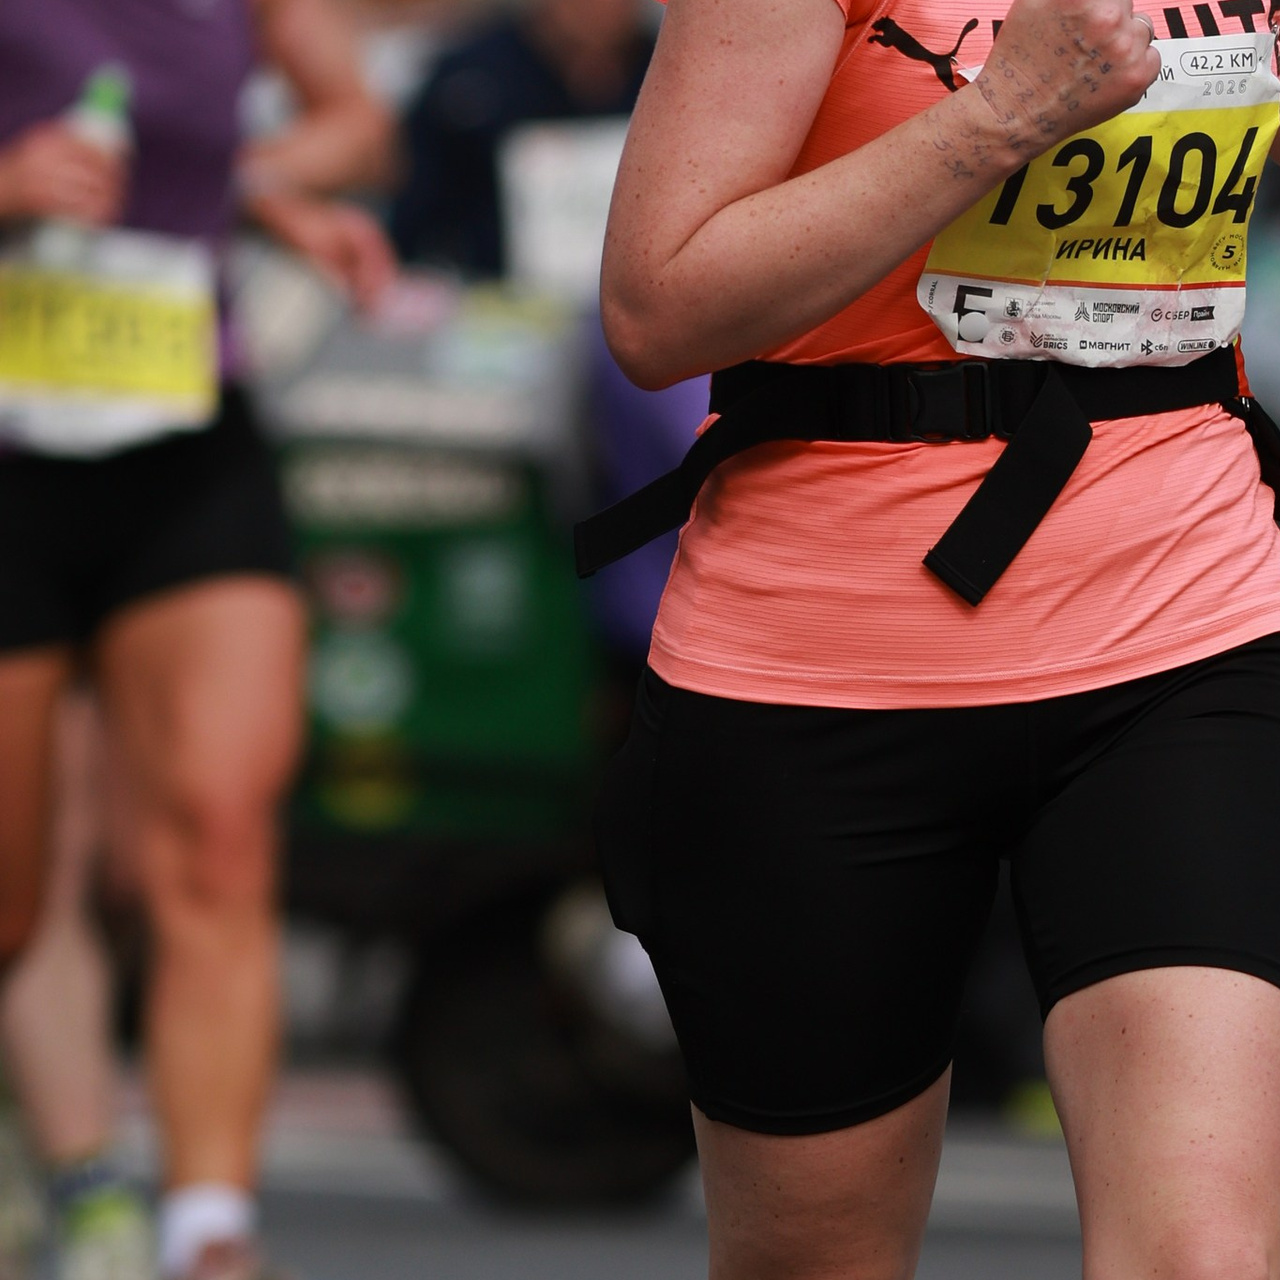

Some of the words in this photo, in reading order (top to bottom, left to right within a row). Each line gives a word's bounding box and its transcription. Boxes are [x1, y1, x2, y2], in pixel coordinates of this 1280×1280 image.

[1190, 54, 1224, 71] 42,2
[1202, 78, 1247, 96] 2026
[988, 127, 1259, 231] 13104
[1055, 237, 1147, 261] ИРИНА
[1221, 245, 1237, 259] 5
[928, 280, 938, 304] CORRAL
[1092, 302, 1140, 314] МОСКОВСКИЙ
[1164, 310, 1190, 320] СБЕР
[1092, 313, 1115, 323] СПОРТ
[1043, 341, 1068, 350] BRICS
[1180, 341, 1208, 350] WINLINE
